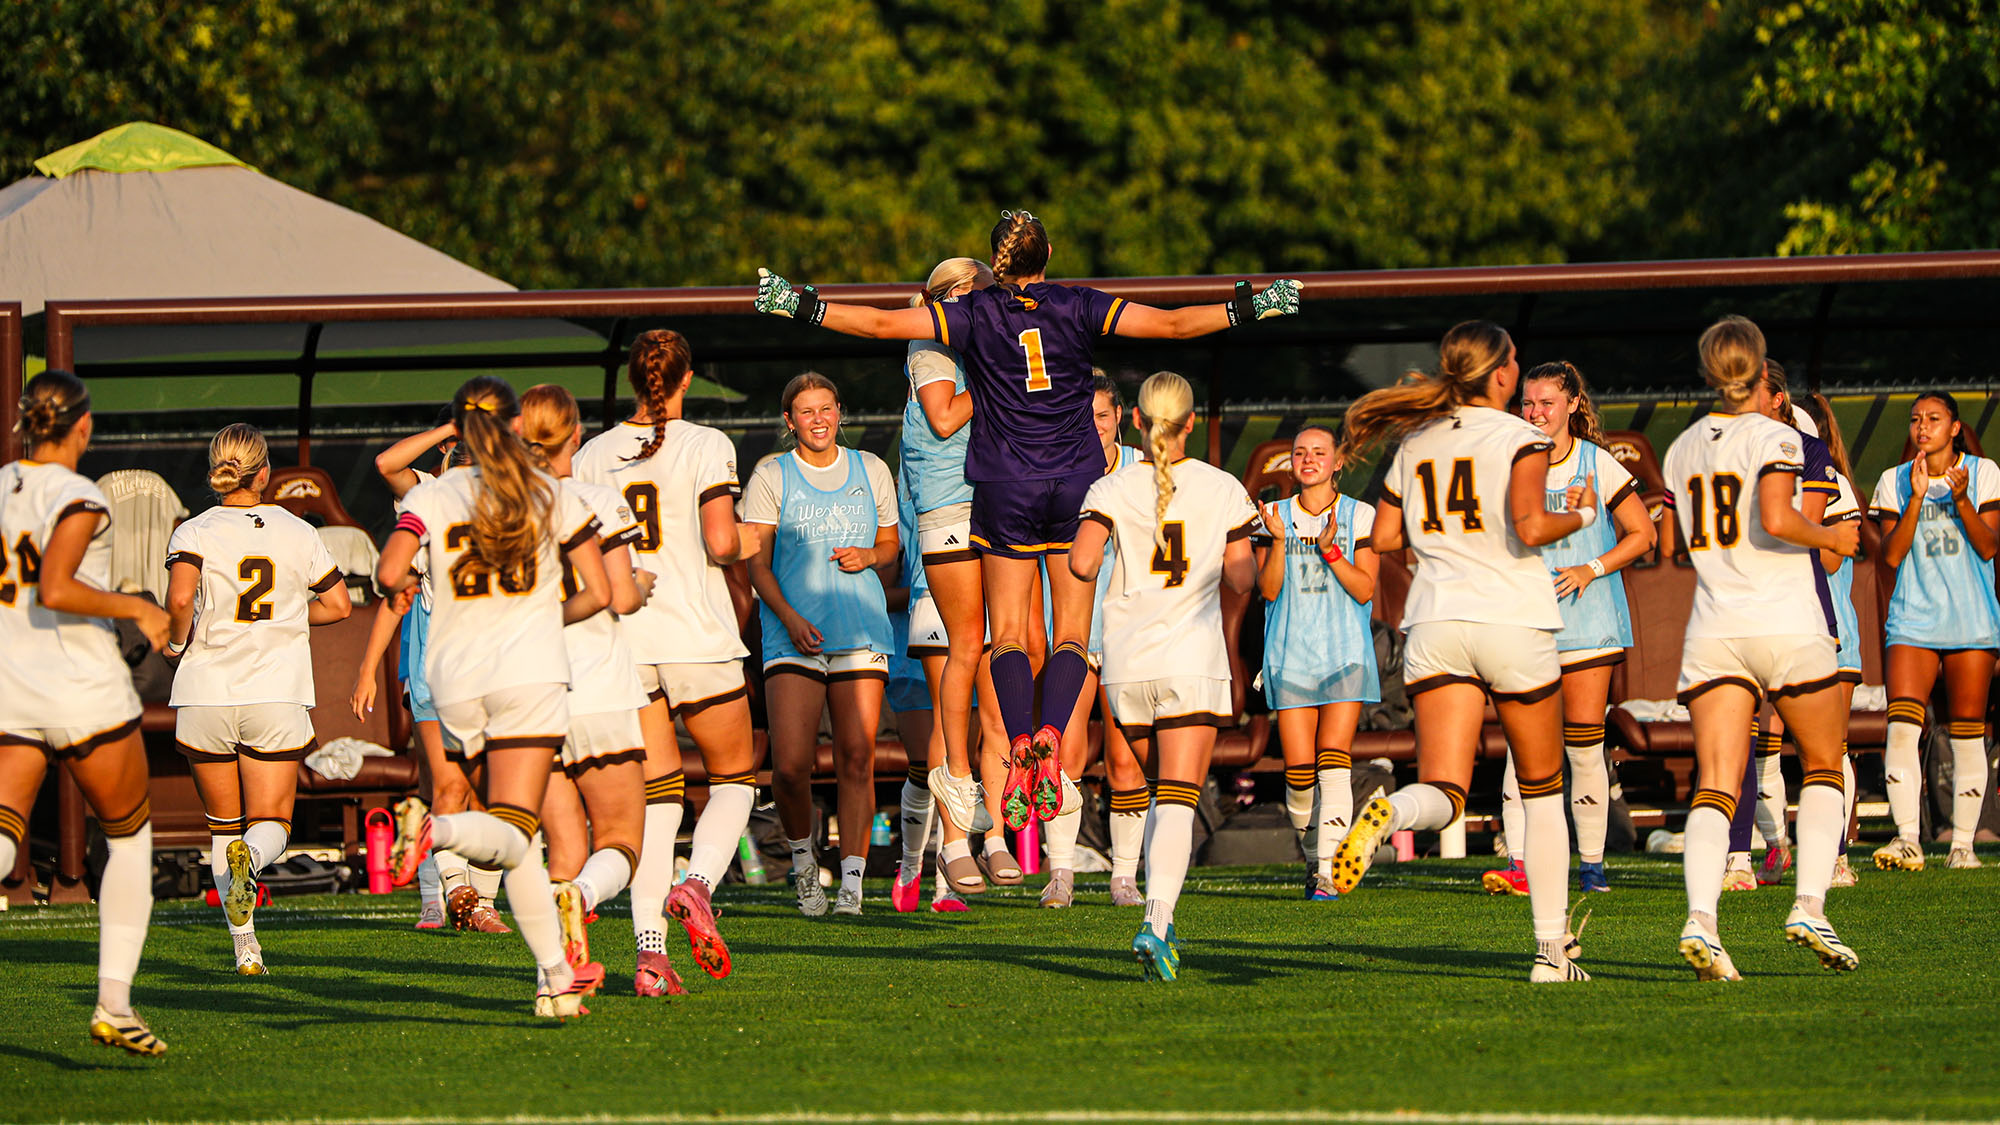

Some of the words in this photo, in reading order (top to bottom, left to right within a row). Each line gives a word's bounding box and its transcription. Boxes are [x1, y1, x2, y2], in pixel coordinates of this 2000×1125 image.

[1018, 327, 1052, 393] 1
[622, 480, 664, 555] 9
[798, 502, 865, 522] Western
[1415, 457, 1486, 535] 14
[1687, 471, 1744, 552] 18
[793, 522, 869, 544] Michigan
[1150, 520, 1191, 590] 4
[234, 555, 276, 623] 2
